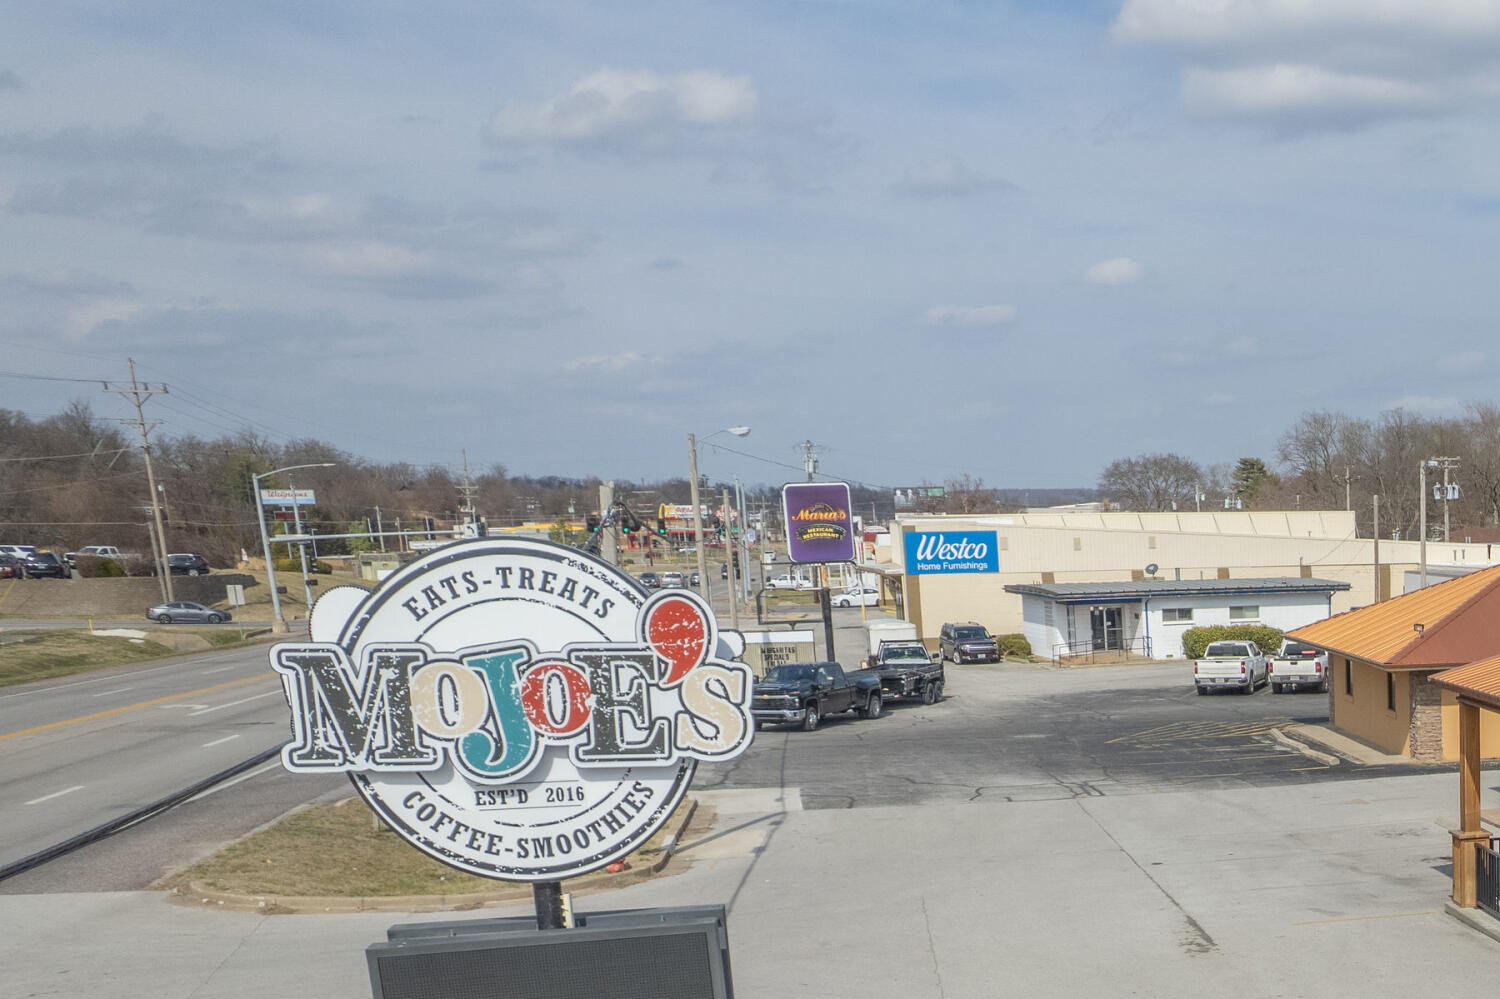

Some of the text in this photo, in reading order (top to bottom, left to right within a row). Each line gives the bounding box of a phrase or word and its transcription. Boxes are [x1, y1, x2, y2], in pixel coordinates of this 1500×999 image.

[791, 508, 847, 521] Maria's
[802, 532, 840, 540] RESTAURANT
[916, 533, 988, 561] Westco
[917, 560, 989, 571] Home Furnishings
[402, 566, 615, 622] EATS-TREATS
[474, 786, 585, 807] EST'D 2016
[403, 780, 655, 859] COFFEE-SMOOTHIES
